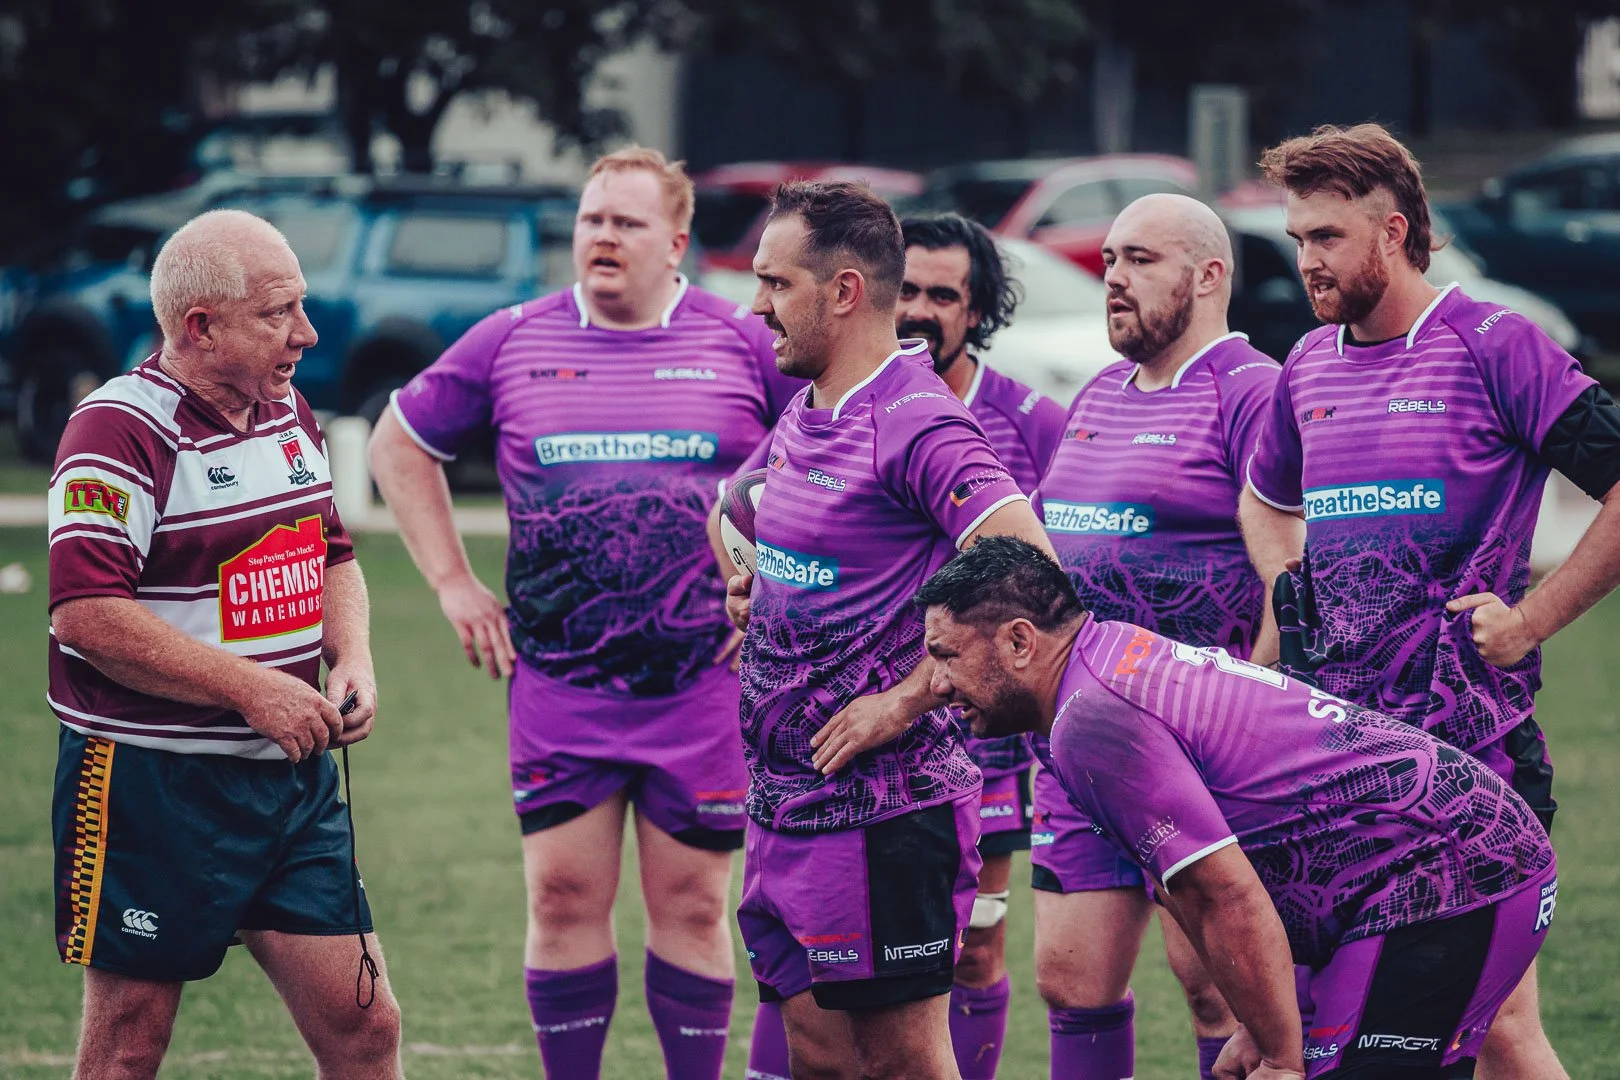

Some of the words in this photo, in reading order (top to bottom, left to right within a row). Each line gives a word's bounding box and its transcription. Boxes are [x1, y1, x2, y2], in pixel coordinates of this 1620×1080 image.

[1387, 400, 1446, 413] REBELS
[540, 433, 716, 460] BreatheSafe
[210, 480, 239, 491] canterbury
[807, 471, 846, 490] REBELS
[1044, 507, 1149, 533] eatheSafe
[248, 557, 264, 567] Stop
[263, 552, 286, 564] Paying
[285, 549, 296, 559] Too
[756, 547, 834, 587] eatheSafe
[228, 555, 325, 606] CHEMIST
[121, 926, 158, 940] canterbury
[808, 949, 859, 962] EBELS
